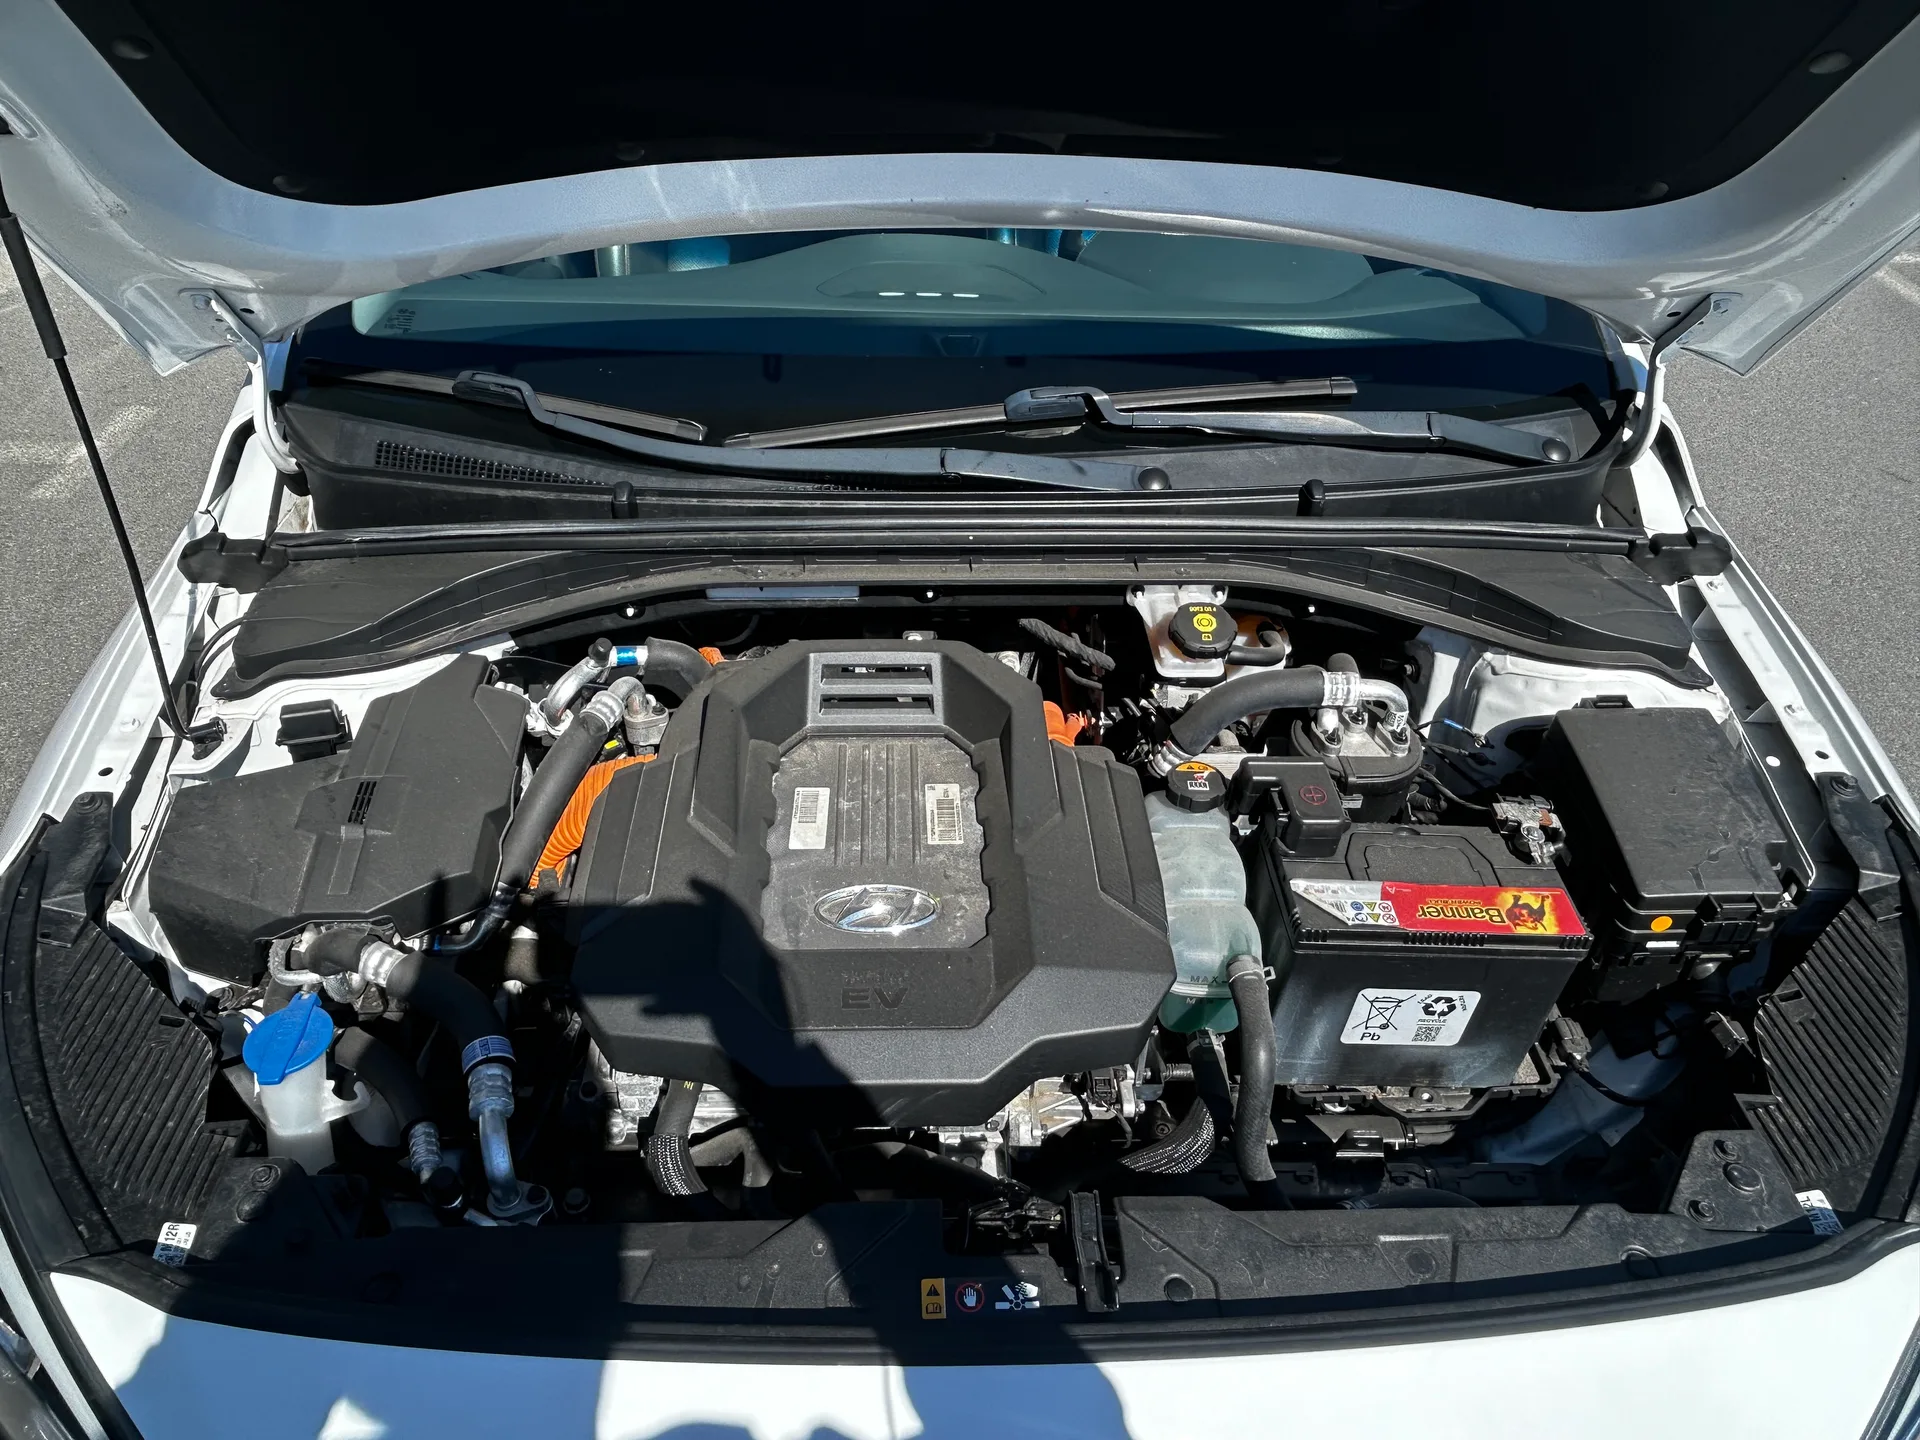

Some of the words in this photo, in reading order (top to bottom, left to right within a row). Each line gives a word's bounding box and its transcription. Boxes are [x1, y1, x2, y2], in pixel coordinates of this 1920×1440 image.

[1417, 905, 1507, 924] Banner
[1190, 975, 1219, 983] MAX
[841, 987, 909, 1010] EV
[1360, 1032, 1381, 1041] Pb
